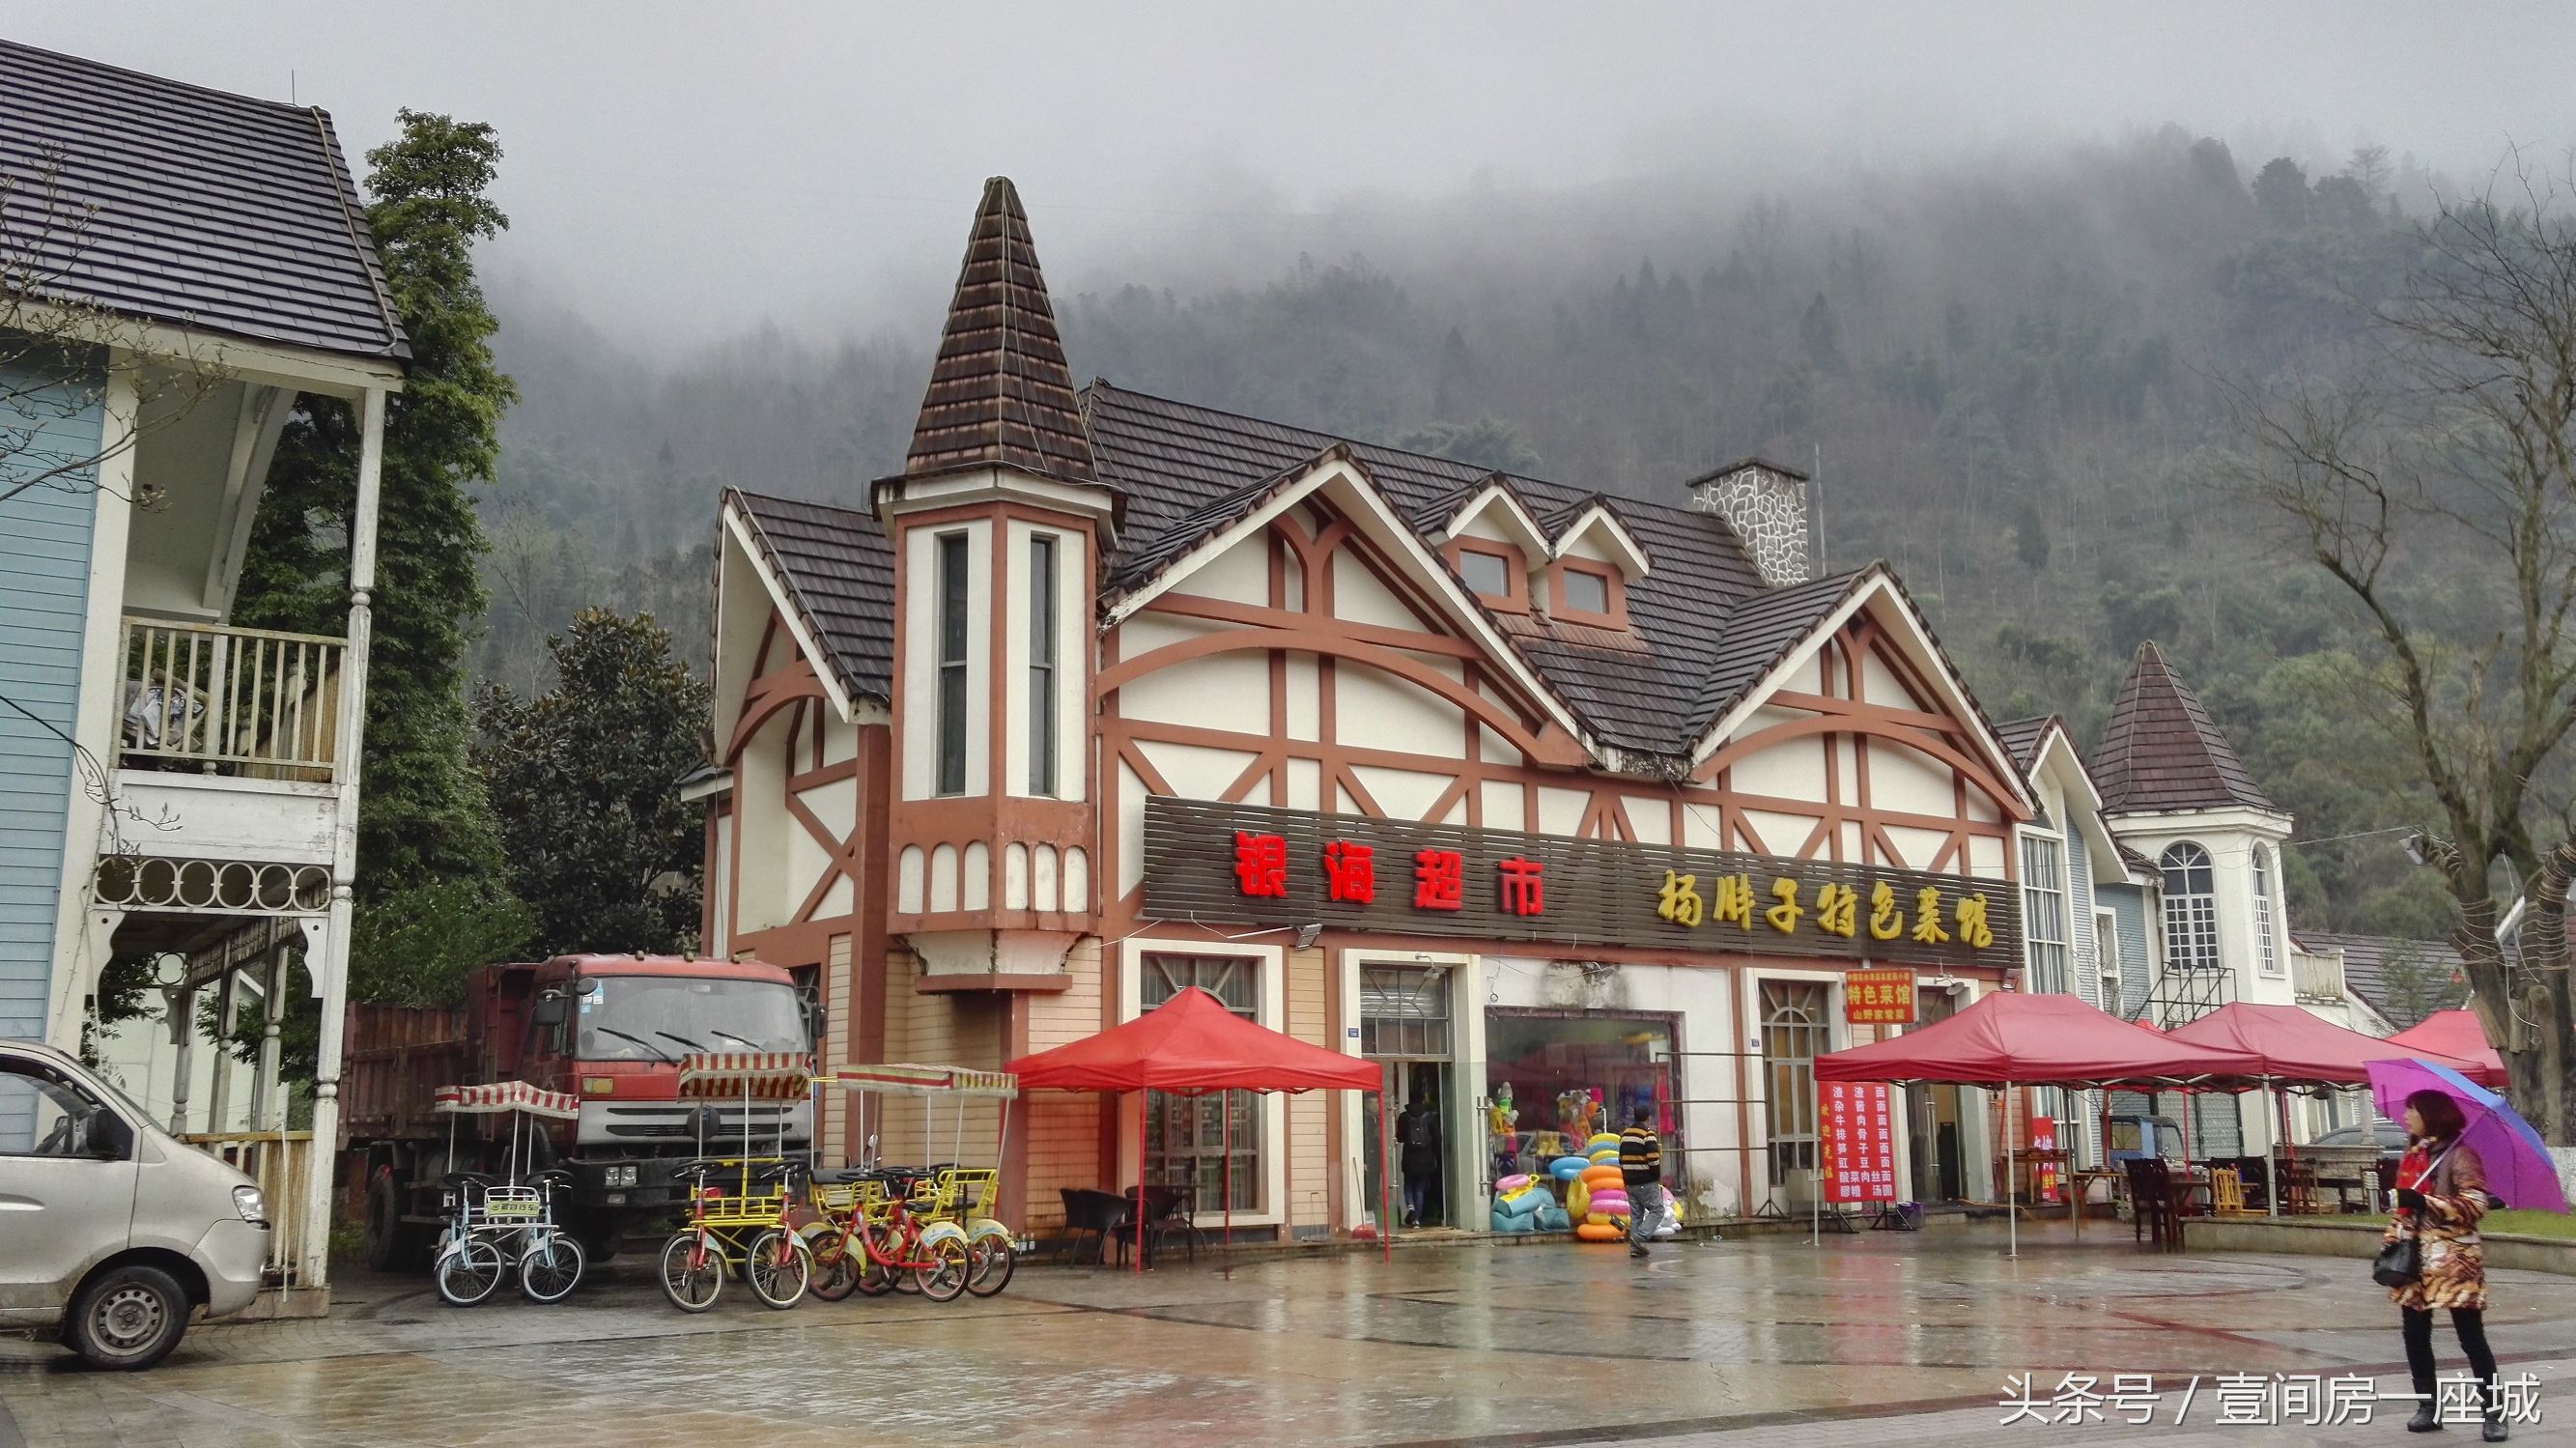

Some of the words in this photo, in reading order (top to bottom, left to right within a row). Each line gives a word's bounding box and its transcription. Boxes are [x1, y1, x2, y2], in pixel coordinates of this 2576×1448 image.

[1235, 831, 1543, 916] 银海超市
[1657, 869, 1994, 949] 杨胖子特色菜馆
[1847, 983, 1911, 1006] 特色菜馆
